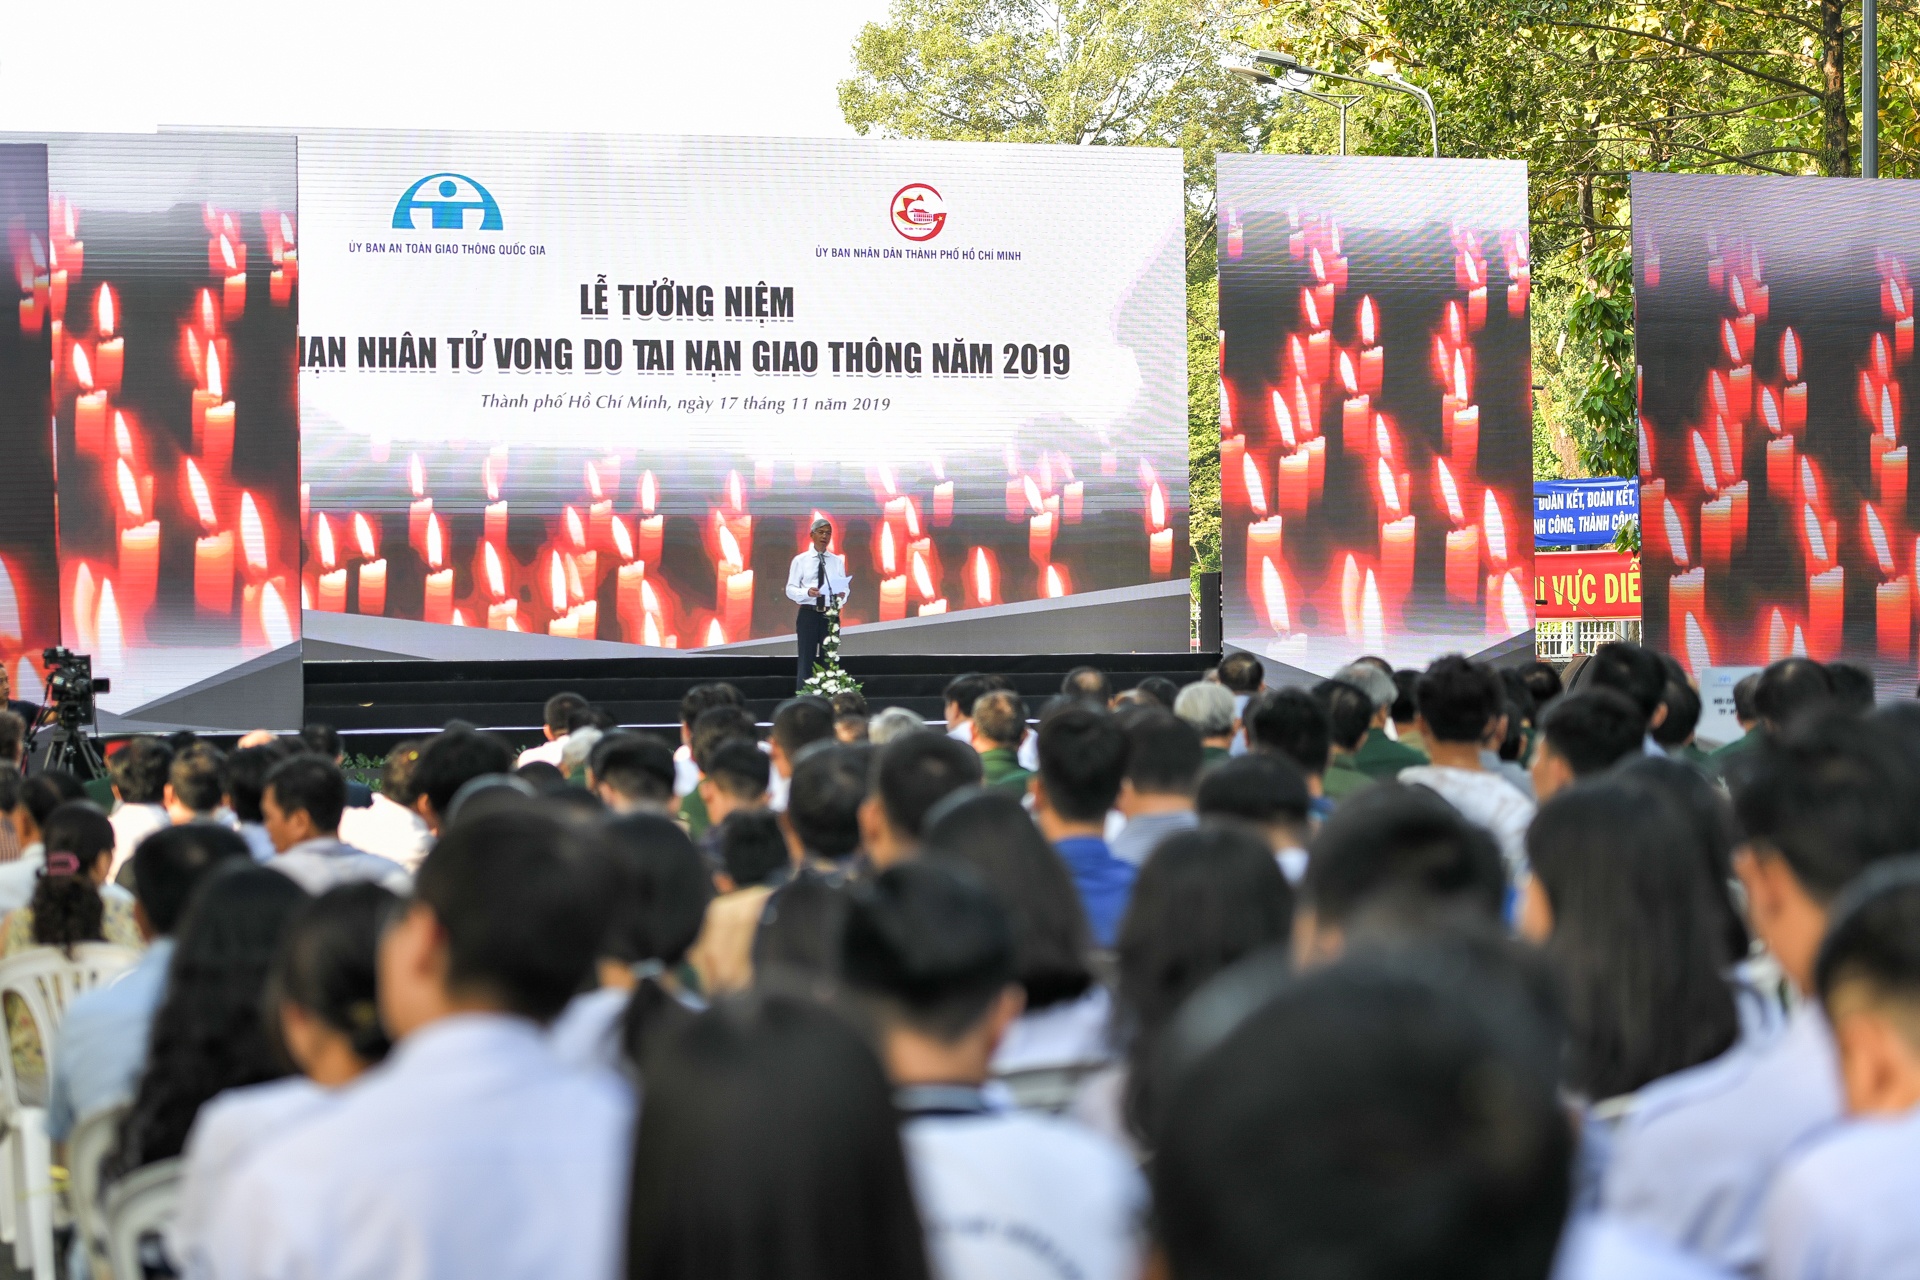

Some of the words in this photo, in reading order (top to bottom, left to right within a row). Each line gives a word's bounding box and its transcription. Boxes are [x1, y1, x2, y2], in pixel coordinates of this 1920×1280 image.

[365, 243, 386, 253] BAN
[388, 243, 403, 253] AN
[406, 240, 432, 254] TOÀN
[434, 244, 459, 254] GIAO
[462, 241, 496, 255] THÔNG
[498, 241, 526, 255] QUỐC
[529, 245, 546, 255] GIA
[831, 247, 851, 258] BAN
[853, 246, 880, 259] NHÂN
[883, 246, 903, 259] DÂN
[906, 245, 938, 260] THÀNH
[940, 246, 960, 260] PHỐ
[962, 246, 976, 261] HỒ
[978, 248, 994, 261] CHÍ
[996, 250, 1022, 261] MINH
[580, 273, 609, 316] LỄ
[618, 277, 714, 317] TƯỞNG
[725, 281, 794, 324] NIỆM
[358, 332, 437, 369] NHÂN
[447, 329, 487, 369] TỬ
[494, 337, 573, 370] VONG
[584, 339, 622, 371] DO
[633, 339, 674, 371] TAI
[685, 340, 741, 378] NẠN
[752, 340, 818, 373] GIAO
[828, 336, 922, 374] THÔNG
[932, 337, 993, 374] NĂM
[1003, 343, 1070, 375] 2019
[481, 393, 528, 409] Thành
[533, 391, 567, 412] phố
[568, 391, 592, 409] Hồ
[596, 394, 624, 409] Chí
[627, 394, 672, 411] Minh,
[677, 396, 714, 413] ngày
[719, 397, 739, 410] 17
[743, 396, 786, 414] tháng
[791, 397, 809, 411] 11
[814, 398, 847, 411] năm
[852, 398, 891, 412] 2019
[1538, 491, 1564, 511] ĐOÀN
[1566, 488, 1585, 510] KẾT,
[1587, 488, 1614, 508] ĐOÀN
[1615, 484, 1635, 507] KẾT,
[1548, 515, 1576, 534] CÔNG,
[1578, 512, 1610, 533] THÀNH
[1552, 568, 1597, 612] VỰC
[1604, 557, 1641, 605] DIỄ
